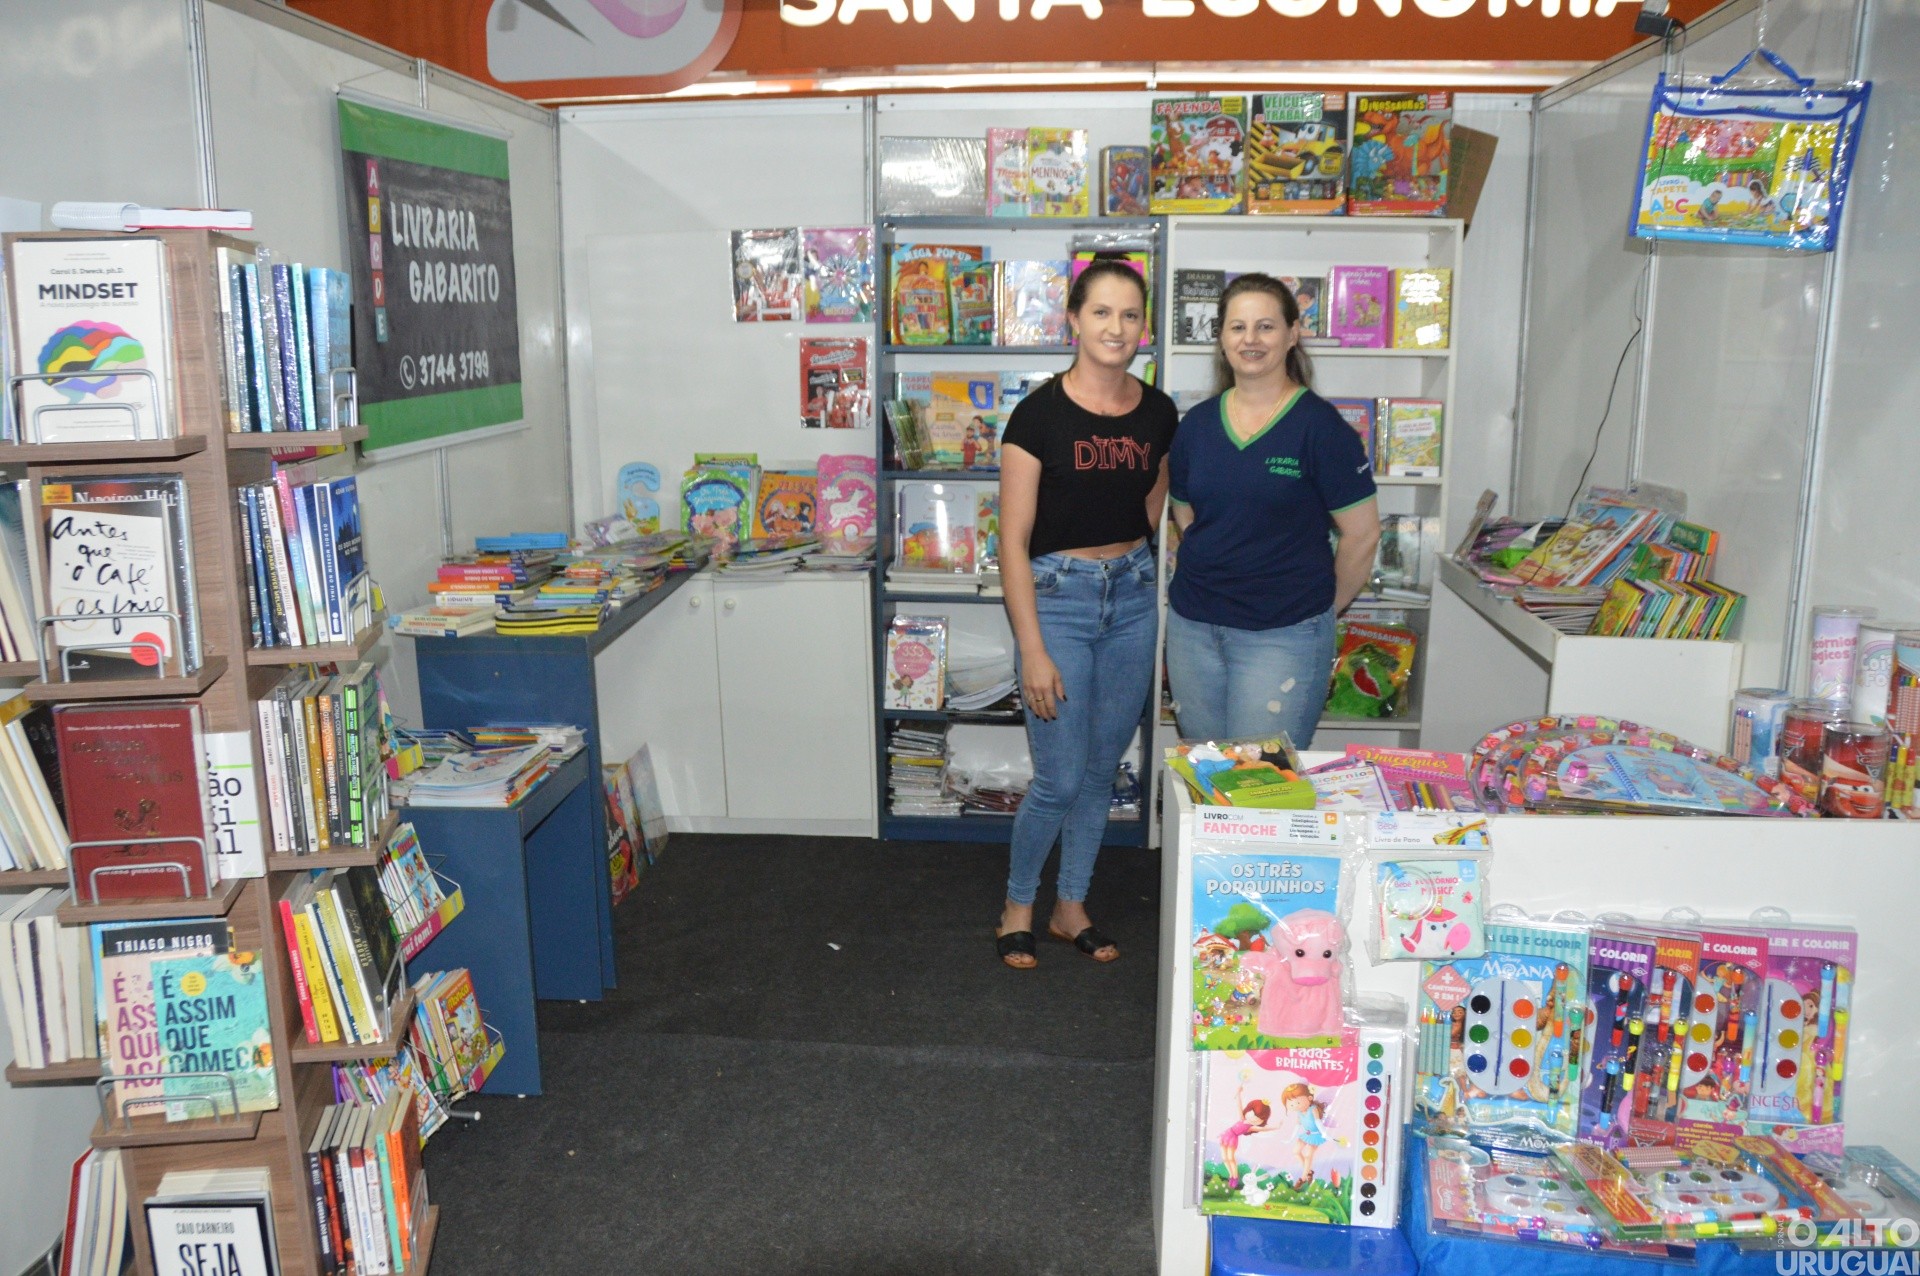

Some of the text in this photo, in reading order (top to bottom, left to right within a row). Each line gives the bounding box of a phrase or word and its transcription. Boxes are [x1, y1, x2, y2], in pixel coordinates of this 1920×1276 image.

[1155, 100, 1220, 116] FAZENDA
[390, 201, 479, 251] LIVRARIA
[373, 242, 380, 262] C
[50, 267, 69, 275] Carol
[39, 282, 138, 300] MINDSET
[375, 278, 382, 300] D
[409, 260, 499, 303] GABARITO
[419, 350, 489, 386] 3744 3799
[1074, 440, 1151, 471] DIMY
[1264, 457, 1299, 466] LIVRARIA
[323, 523, 329, 531] OS
[329, 575, 334, 583] NO
[273, 590, 282, 616] MELHOR
[1204, 813, 1228, 821] LIVRO
[1203, 821, 1277, 837] FANTOCHE
[1231, 861, 1302, 878] OS TRÊS
[1205, 879, 1326, 895] PORQUINHOS
[115, 934, 213, 953] THIAGO NIGRO
[1500, 936, 1582, 949] LER E COLORIR
[1703, 943, 1758, 956] E COLORIR
[1769, 938, 1849, 950] LER E COLORIR
[354, 938, 369, 968] HOOVER
[1599, 948, 1648, 963] COLORIR
[1482, 960, 1555, 980] MOANA
[113, 970, 128, 1004] É
[162, 969, 175, 999] É
[165, 995, 236, 1026] ASSIM
[166, 1025, 211, 1051] QUE
[1275, 1057, 1344, 1071] BRILHANTES
[176, 1222, 235, 1234] CAIO CARNEIRO
[179, 1243, 243, 1276] SEJA
